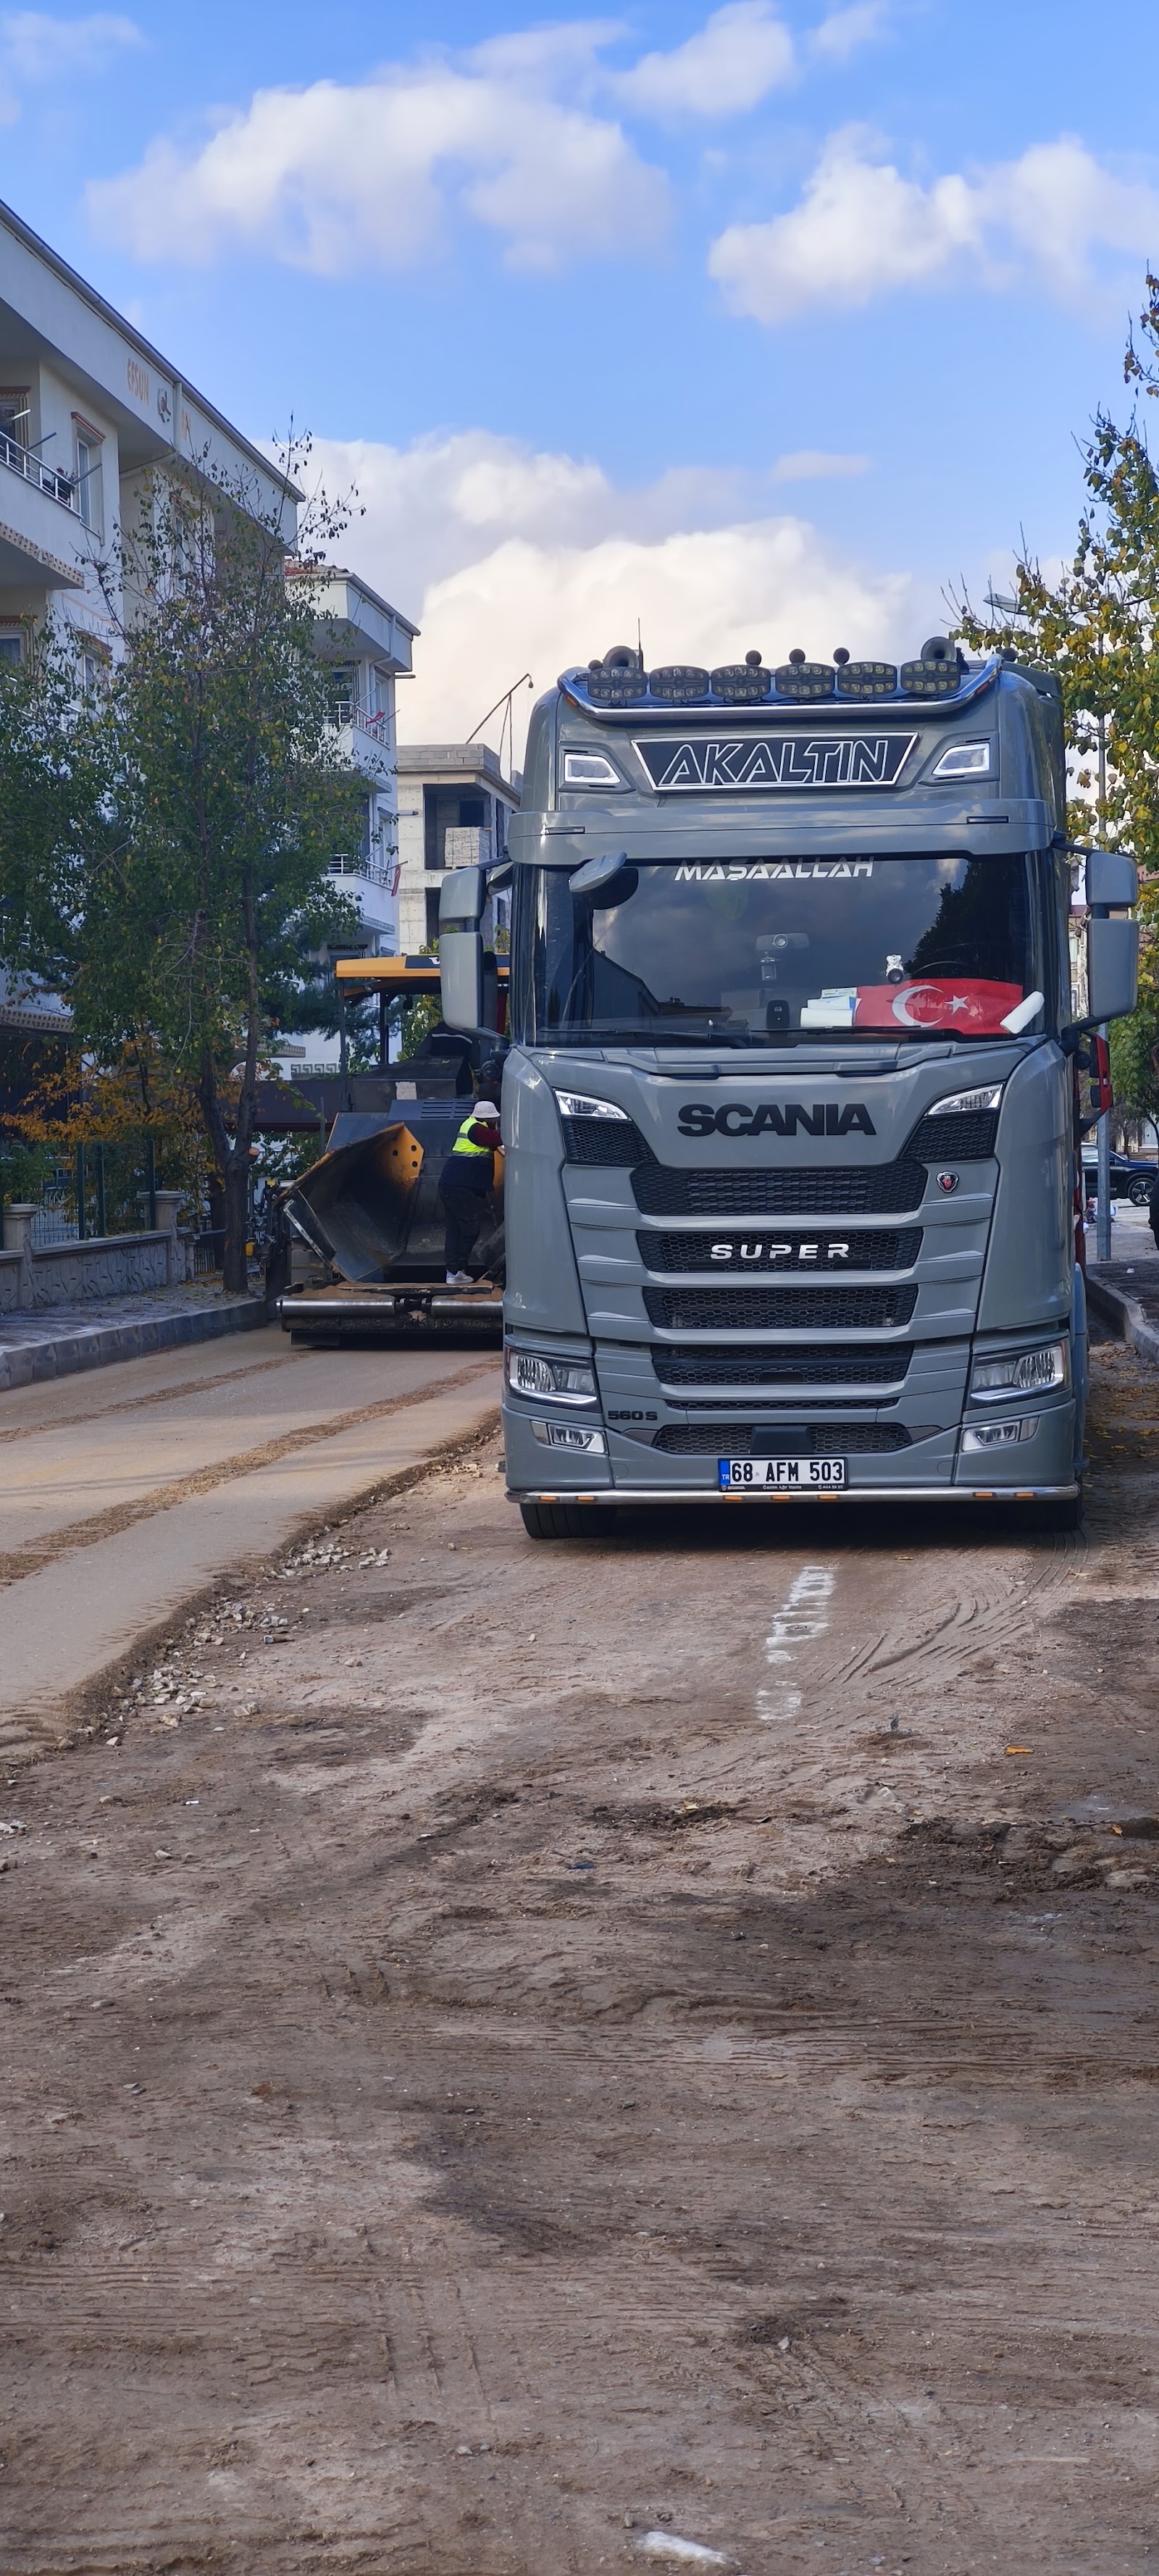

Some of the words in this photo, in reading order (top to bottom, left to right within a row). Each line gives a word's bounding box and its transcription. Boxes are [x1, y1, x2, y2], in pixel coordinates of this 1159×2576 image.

[658, 740, 889, 786] AKALTIN
[674, 856, 874, 881] MAŞAALLAH
[677, 1103, 876, 1137] SCANIA
[710, 1243, 850, 1259] SUPER
[608, 1410, 643, 1420] 560
[645, 1411, 658, 1421] S
[732, 1463, 753, 1482] 68
[766, 1462, 798, 1482] AFM
[810, 1461, 842, 1481] 503
